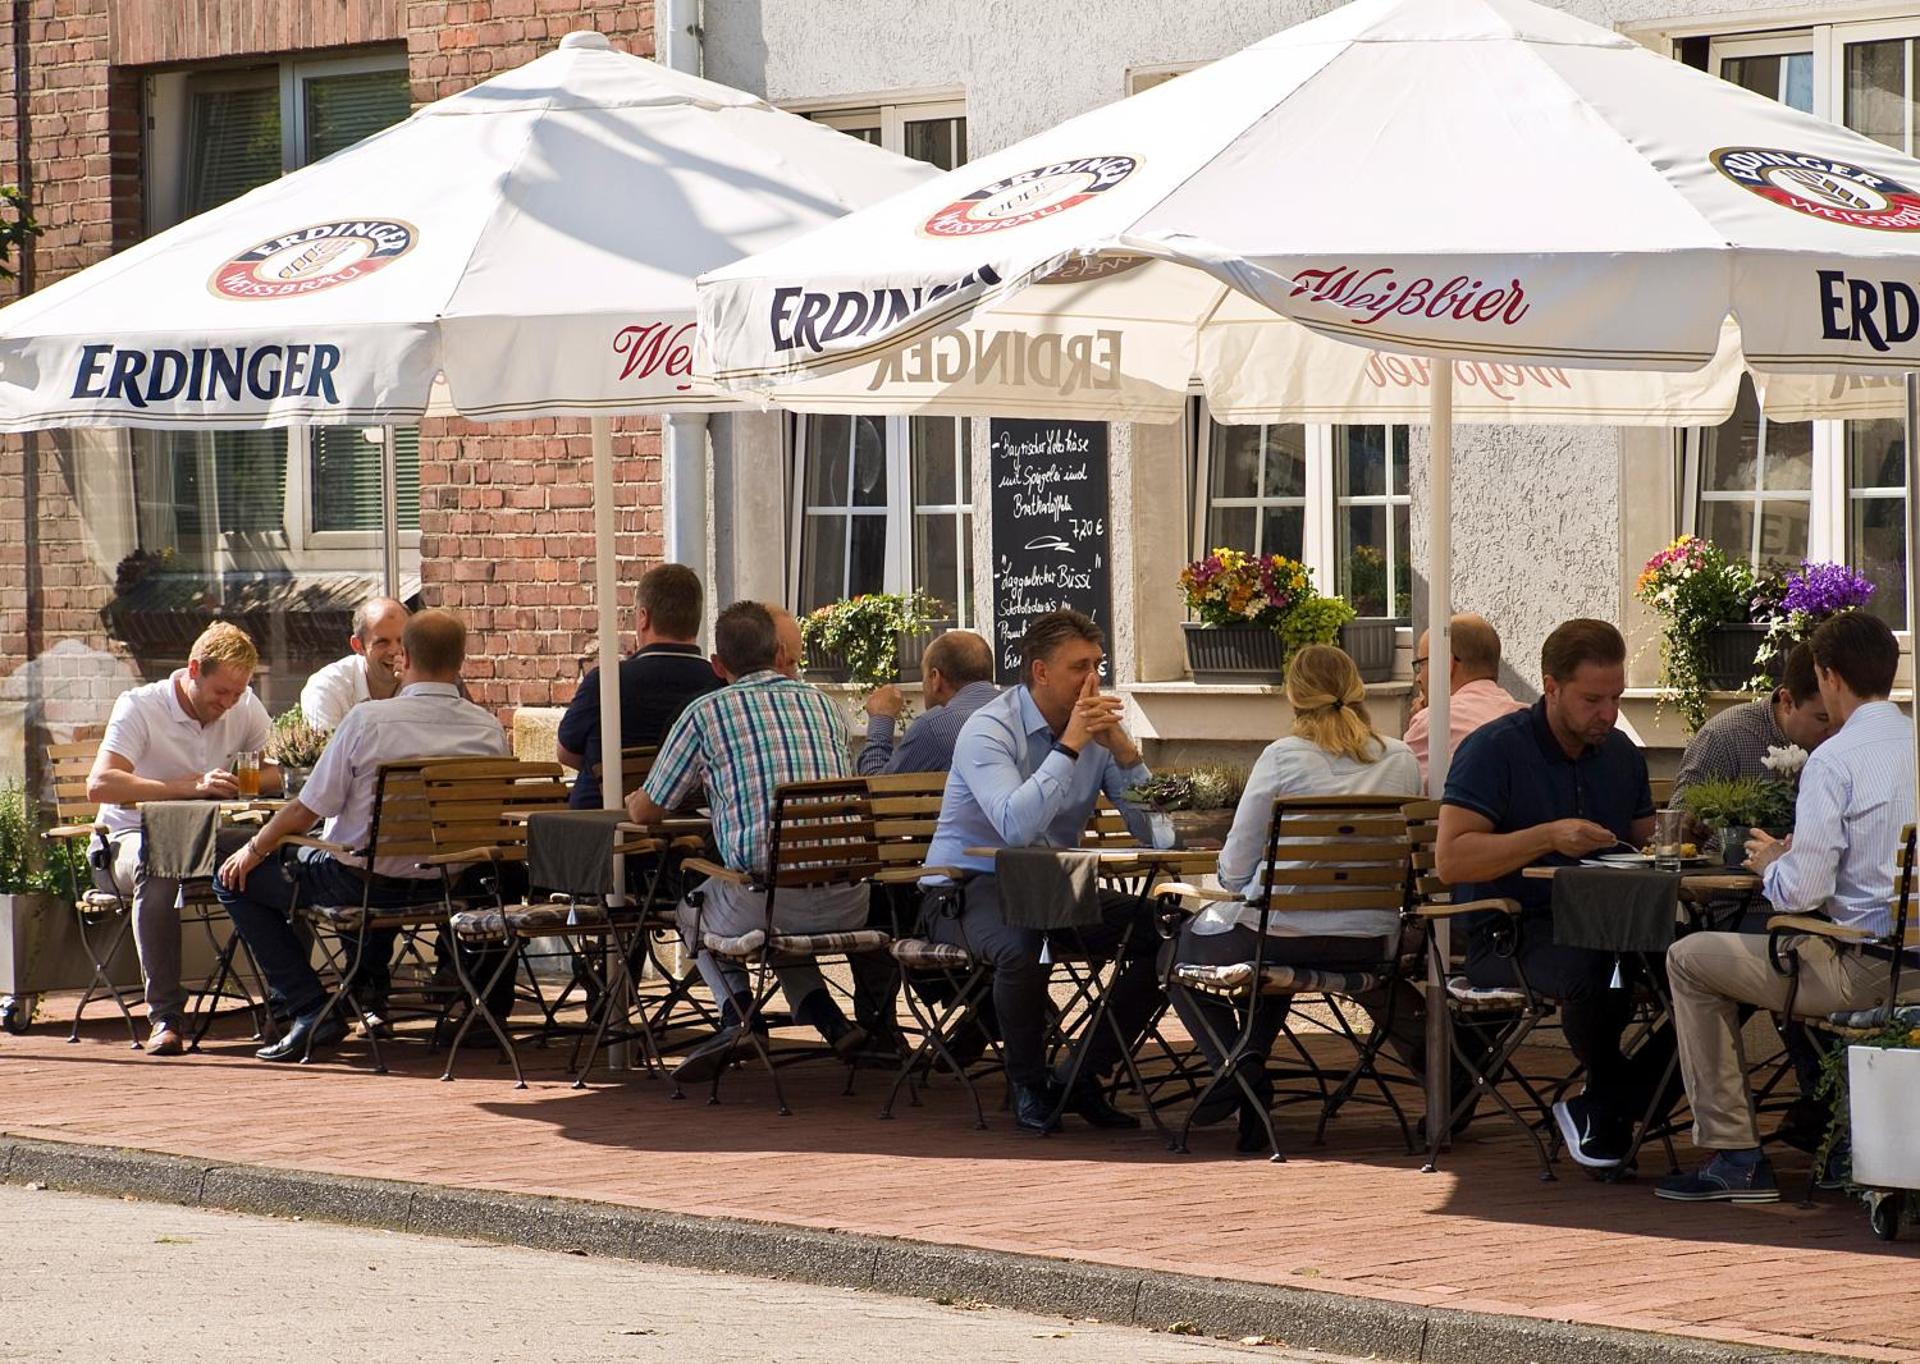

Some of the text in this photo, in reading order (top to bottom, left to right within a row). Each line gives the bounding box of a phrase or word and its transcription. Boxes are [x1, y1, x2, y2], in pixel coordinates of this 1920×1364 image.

[1724, 152, 1884, 188] ERDINGER
[252, 223, 407, 256] ERDINGER
[770, 265, 1002, 353] ERDIN
[1289, 265, 1530, 325] Weißbier
[69, 344, 341, 408] ERDINGER
[1068, 518, 1104, 541] 7,20 €
